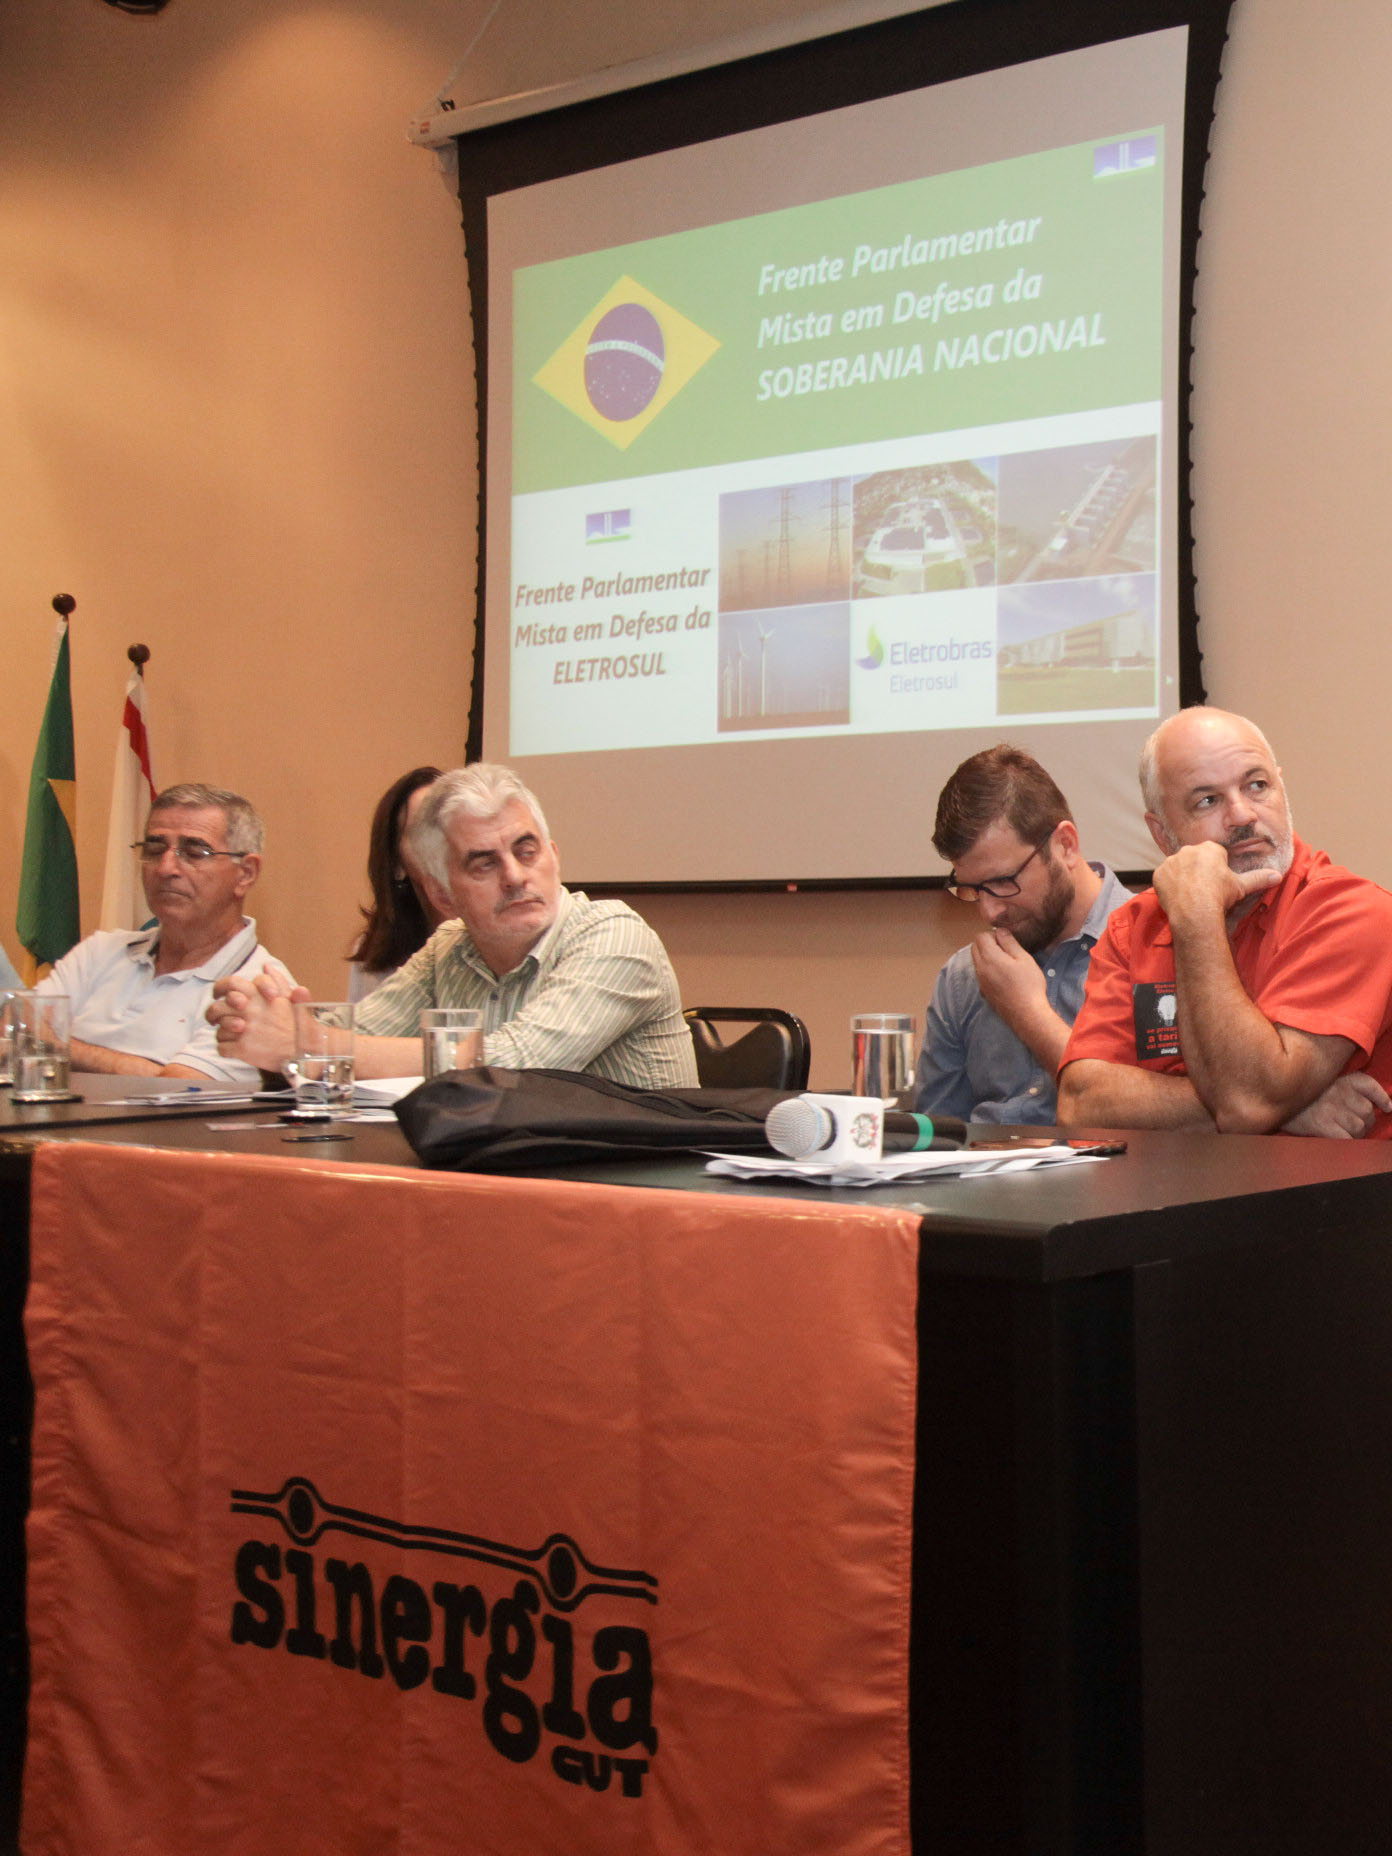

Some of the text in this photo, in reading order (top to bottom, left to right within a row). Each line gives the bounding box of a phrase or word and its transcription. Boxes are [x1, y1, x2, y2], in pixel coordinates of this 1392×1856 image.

[758, 217, 1042, 296] Frente Parlamentar
[758, 268, 1043, 348] Mista em Defesa da
[756, 312, 1107, 401] SOBERANIA NACIONAL
[515, 567, 711, 608] Frente Parlamentar
[514, 605, 711, 648] Mista em Defesa da
[552, 652, 666, 684] ELETROSUL
[890, 637, 992, 665] Eletrobras
[889, 672, 958, 693] Eletrosul
[231, 1540, 658, 1764] sinergia
[550, 1745, 650, 1799] CUT
